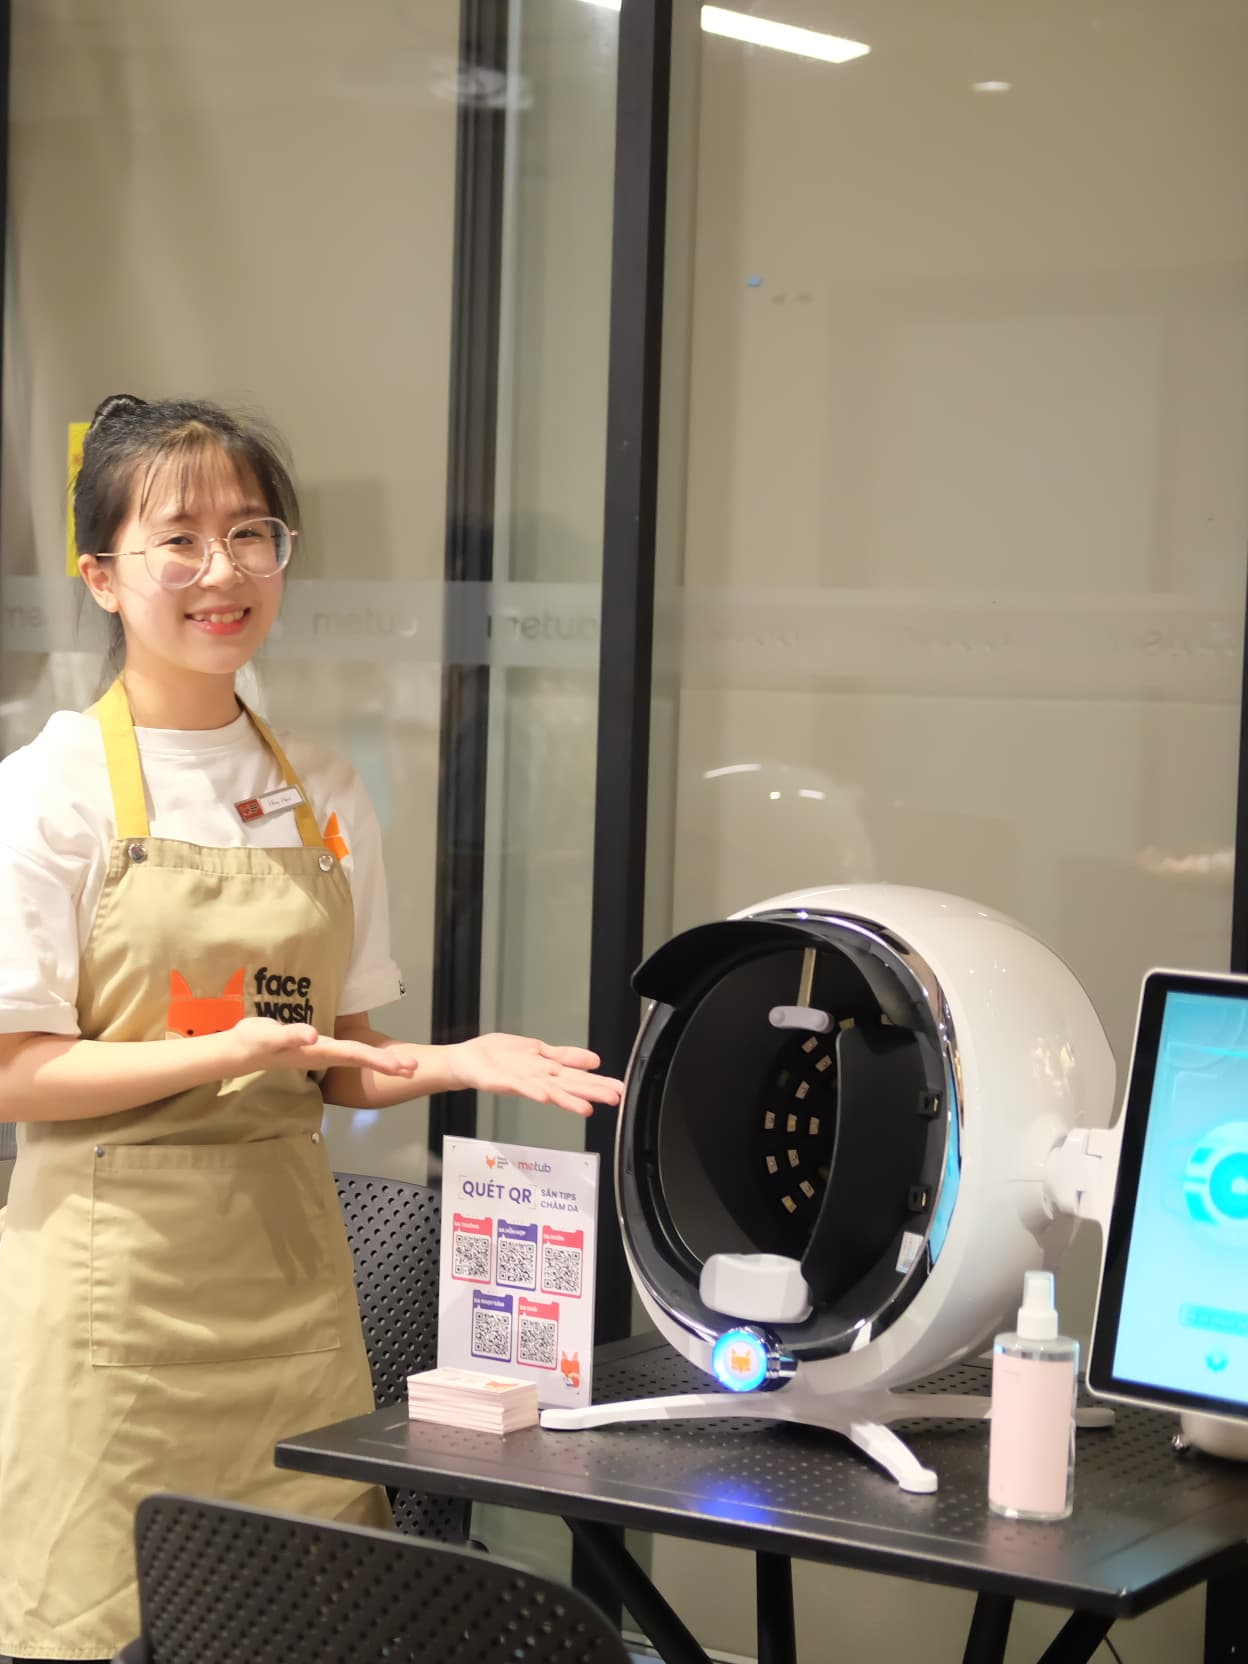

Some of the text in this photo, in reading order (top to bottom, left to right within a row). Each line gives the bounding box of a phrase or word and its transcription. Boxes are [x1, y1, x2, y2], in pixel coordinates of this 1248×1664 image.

[254, 966, 312, 998] face
[254, 997, 314, 1025] wash
[517, 1160, 552, 1173] metub
[462, 1179, 532, 1204] QUÉT QR
[559, 1191, 577, 1201] TIPS
[567, 1204, 579, 1212] DA
